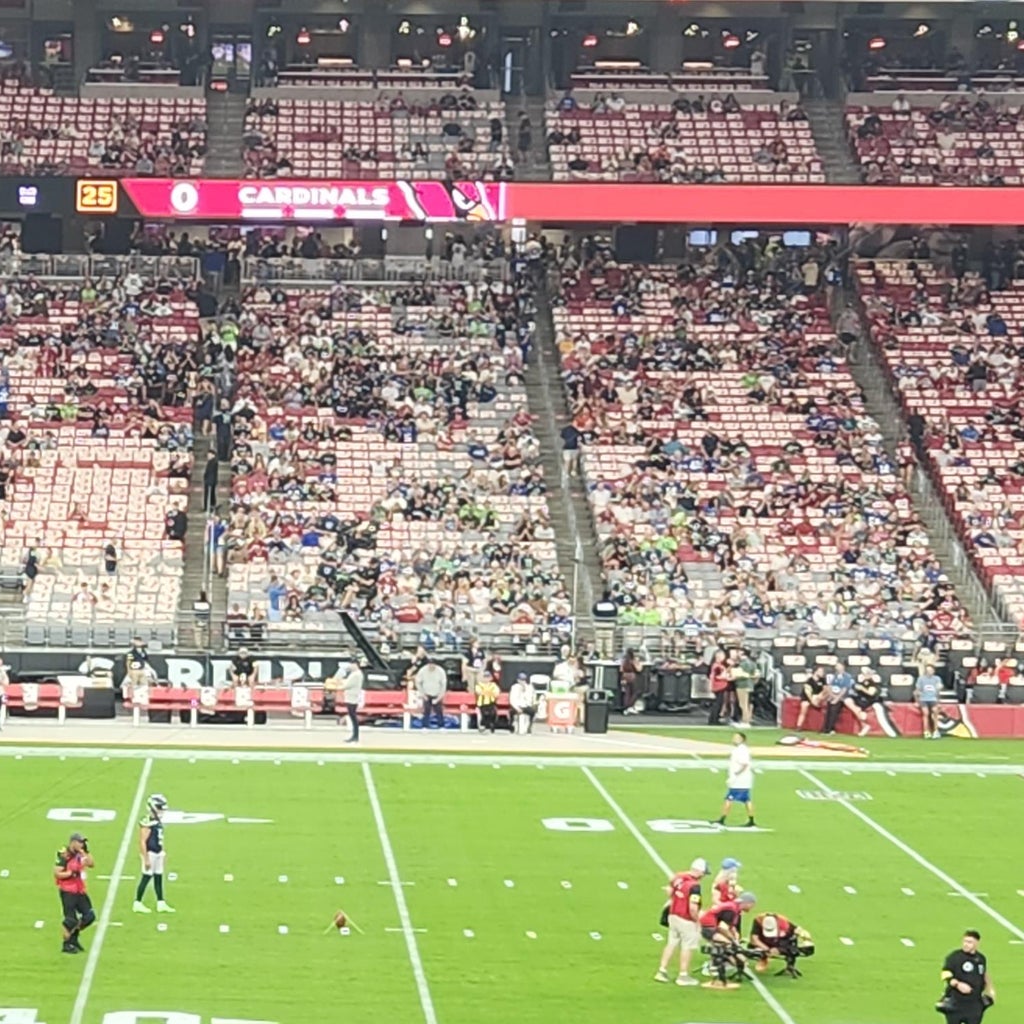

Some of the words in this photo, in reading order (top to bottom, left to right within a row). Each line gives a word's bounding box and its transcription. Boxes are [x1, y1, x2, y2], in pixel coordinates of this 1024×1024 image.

[81, 186, 113, 206] 25
[171, 183, 199, 212] 0
[238, 187, 389, 206] CARDINALS
